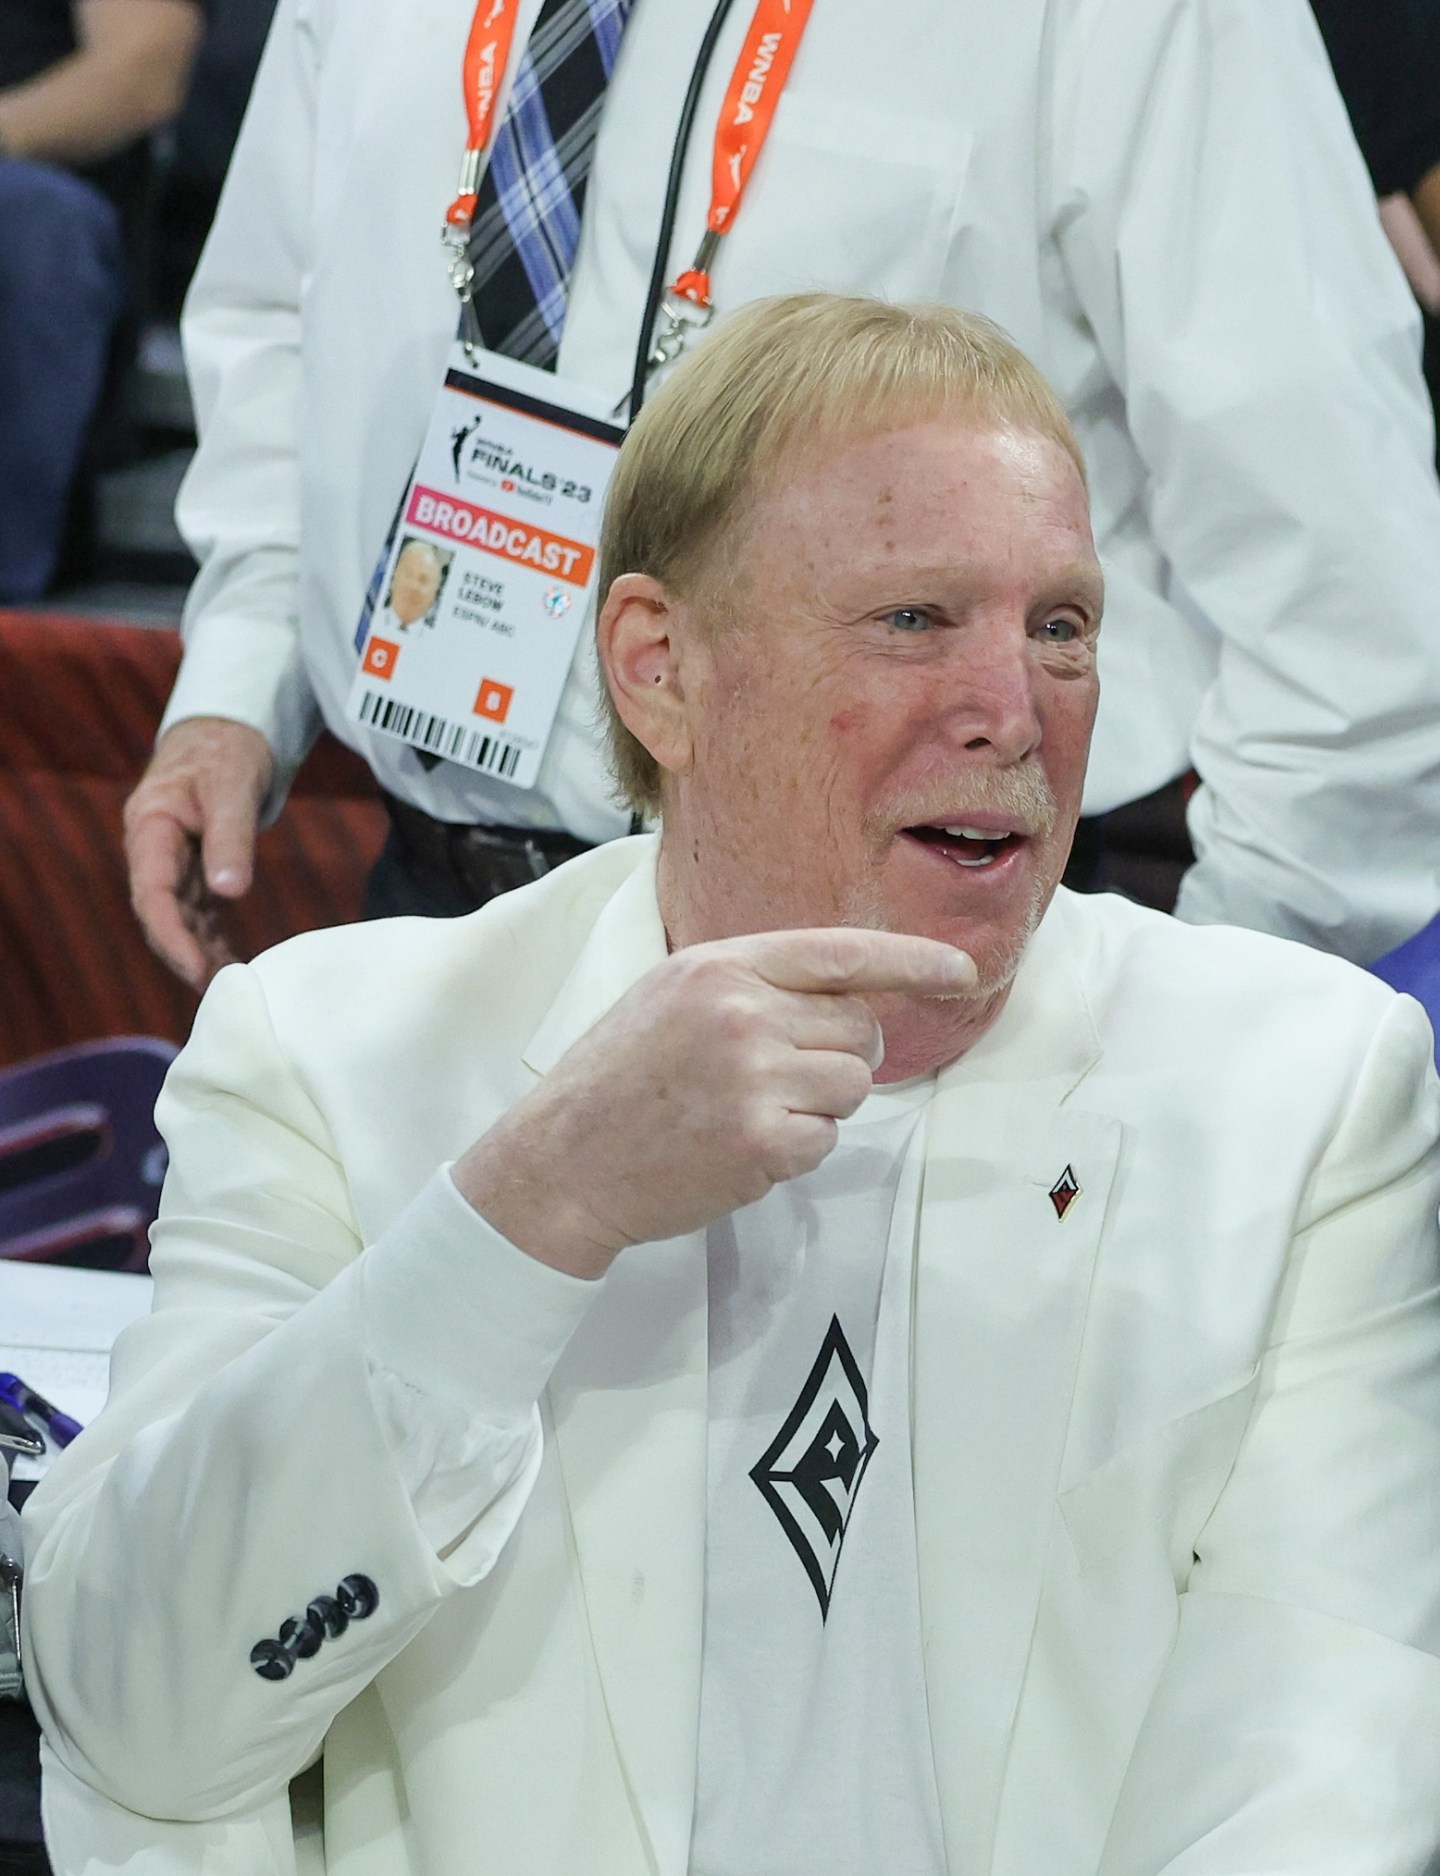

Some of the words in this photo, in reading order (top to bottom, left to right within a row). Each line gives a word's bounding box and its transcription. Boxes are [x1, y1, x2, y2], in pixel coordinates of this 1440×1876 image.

[733, 33, 783, 125] WNBA
[414, 494, 582, 576] BROADCAST
[464, 571, 504, 595] STEVE
